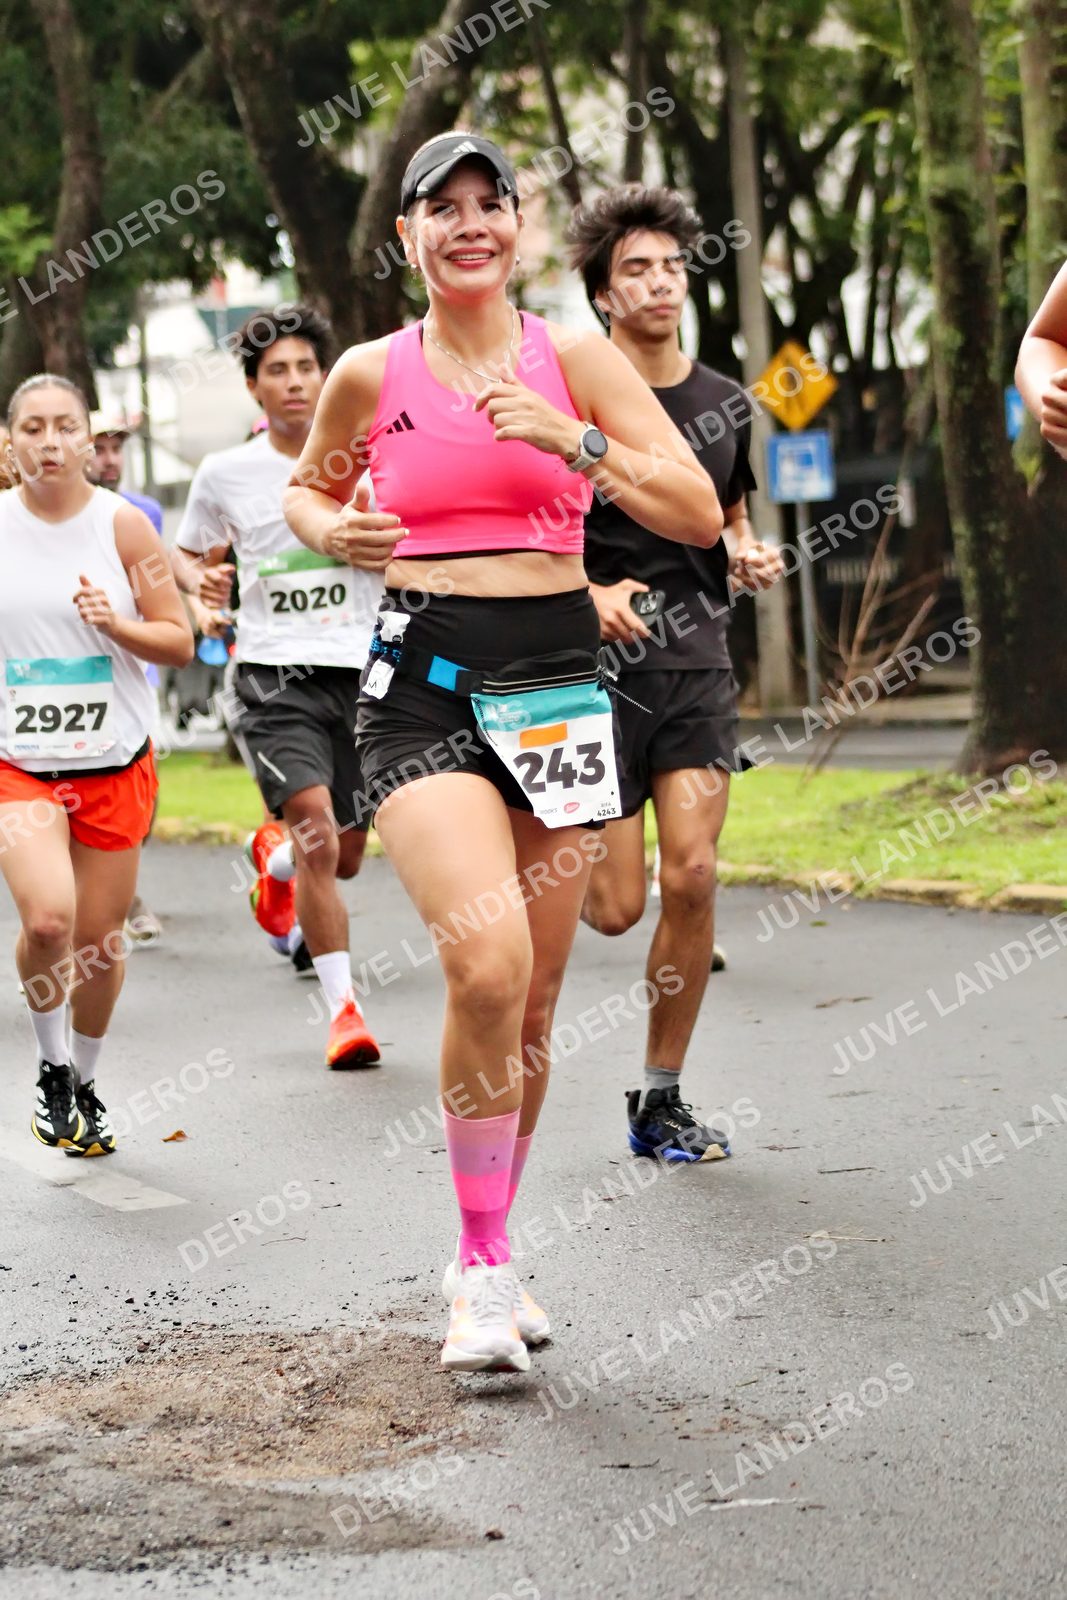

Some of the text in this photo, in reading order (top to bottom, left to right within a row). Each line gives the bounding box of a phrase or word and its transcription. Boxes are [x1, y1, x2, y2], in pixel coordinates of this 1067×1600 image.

[269, 583, 346, 613] 2020
[15, 702, 108, 734] 2927
[513, 741, 606, 794] 243
[597, 807, 616, 817] 4243
